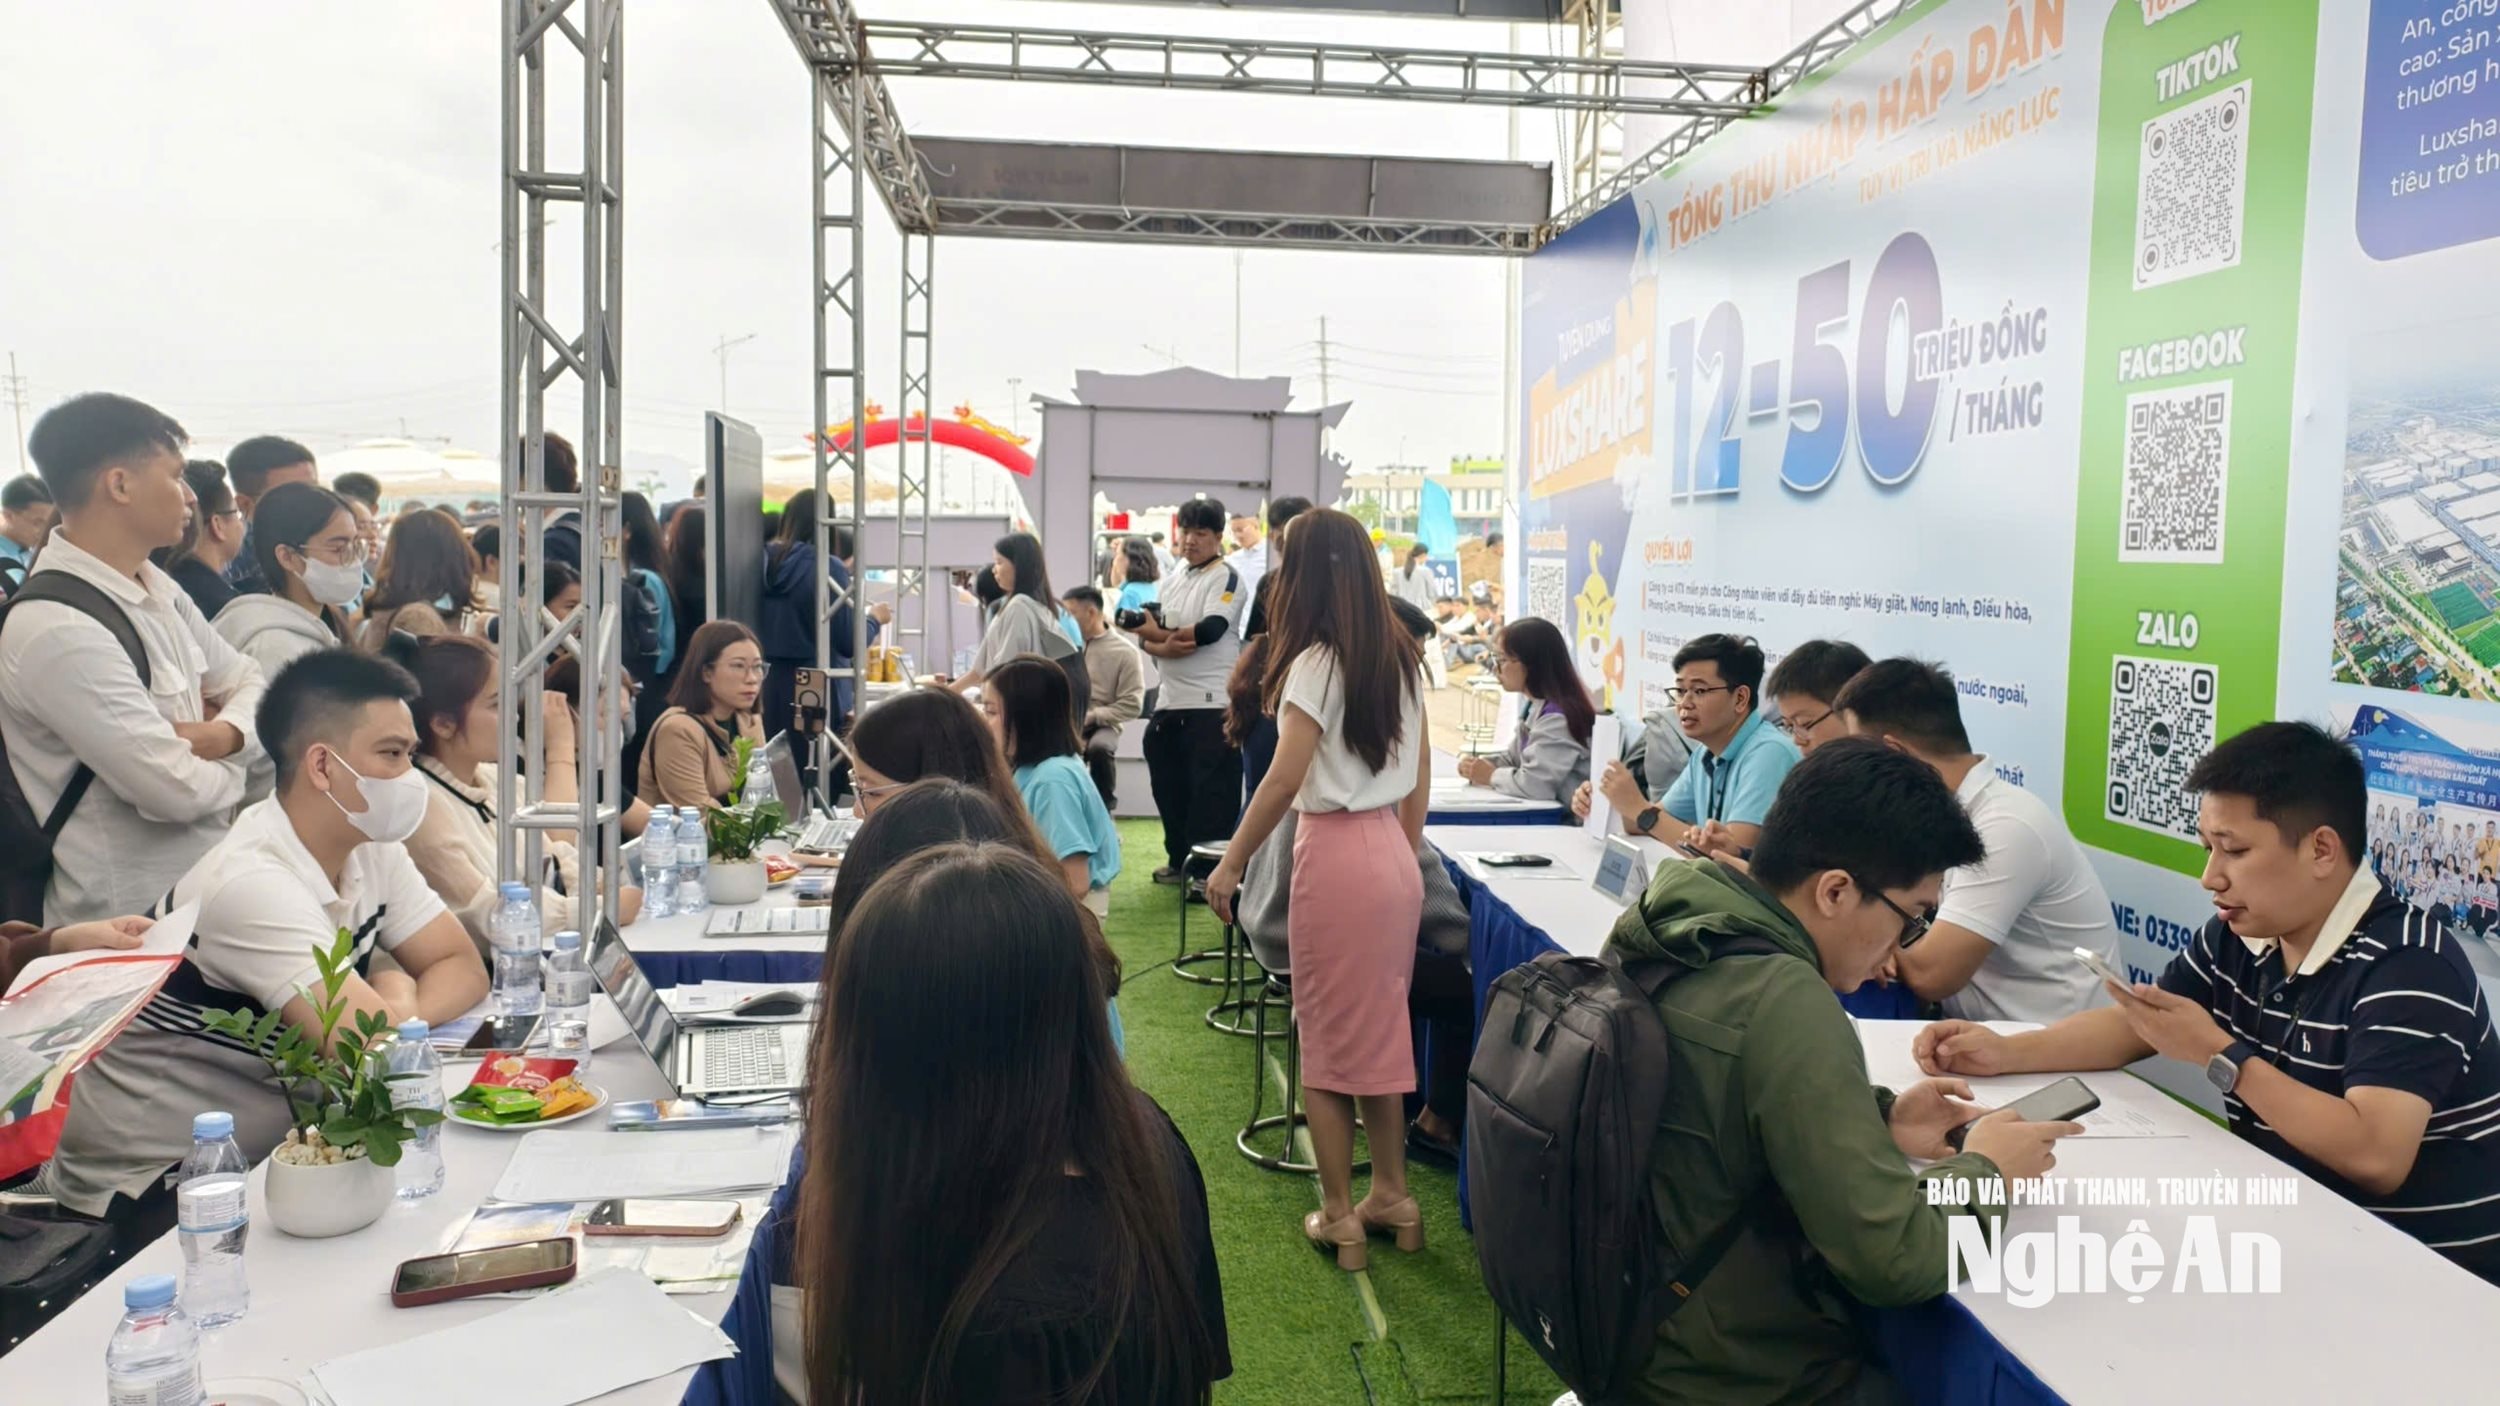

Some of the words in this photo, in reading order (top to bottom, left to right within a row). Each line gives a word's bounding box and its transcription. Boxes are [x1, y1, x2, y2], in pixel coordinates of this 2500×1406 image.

[2399, 46, 2443, 77] cao:
[2448, 26, 2489, 60] Sản
[2401, 18, 2436, 44] An,
[2156, 34, 2241, 103] TIKTOK
[2397, 66, 2477, 111] thương
[1668, 182, 1723, 250] TỔNG
[1730, 152, 1777, 215] THU
[1784, 98, 1867, 181] NHẬP
[1877, 33, 1954, 141] HẤP
[1937, 128, 1959, 168] VÀ
[1963, 115, 2015, 156] NĂNG
[2020, 86, 2061, 135] LỰC
[2420, 117, 2500, 156] Luxsha
[2391, 164, 2431, 198] tiêu
[2438, 152, 2469, 184] trở
[1914, 317, 1974, 383] TRIỆU
[1980, 299, 2048, 364] ĐỒNG
[2118, 326, 2246, 382] FACEBOOK
[1666, 231, 1943, 502] 12-50
[1534, 339, 1647, 483] LUXSHARE
[1966, 376, 2044, 436] THÁNG
[1863, 593, 1883, 614] Máy
[1885, 594, 1908, 615] giặt,
[1910, 595, 1939, 617] Nóng
[1942, 597, 1970, 619] lạnh,
[1973, 597, 2001, 619] Điều
[2005, 601, 2032, 624] hòa,
[2137, 611, 2198, 648] ZALO
[1958, 678, 1986, 697] nước
[1989, 684, 2028, 707] ngoài,
[2150, 731, 2171, 747] Zalo
[1995, 764, 2024, 787] nhất
